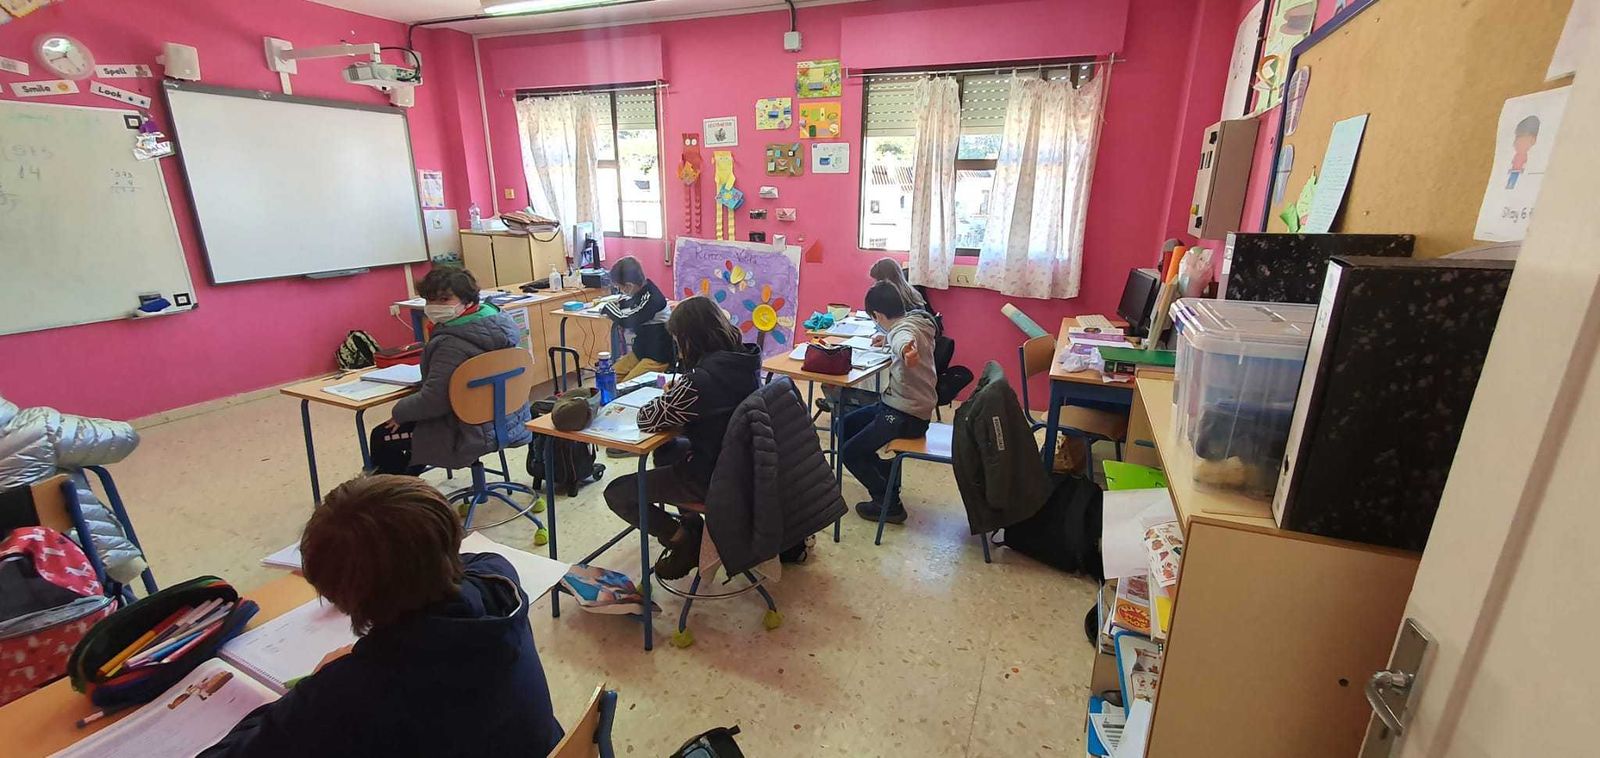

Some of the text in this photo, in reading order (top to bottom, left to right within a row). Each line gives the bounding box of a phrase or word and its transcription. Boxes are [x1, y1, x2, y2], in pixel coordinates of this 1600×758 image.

[103, 67, 127, 76] Spell
[22, 85, 51, 93] Smile
[98, 86, 122, 99] Look
